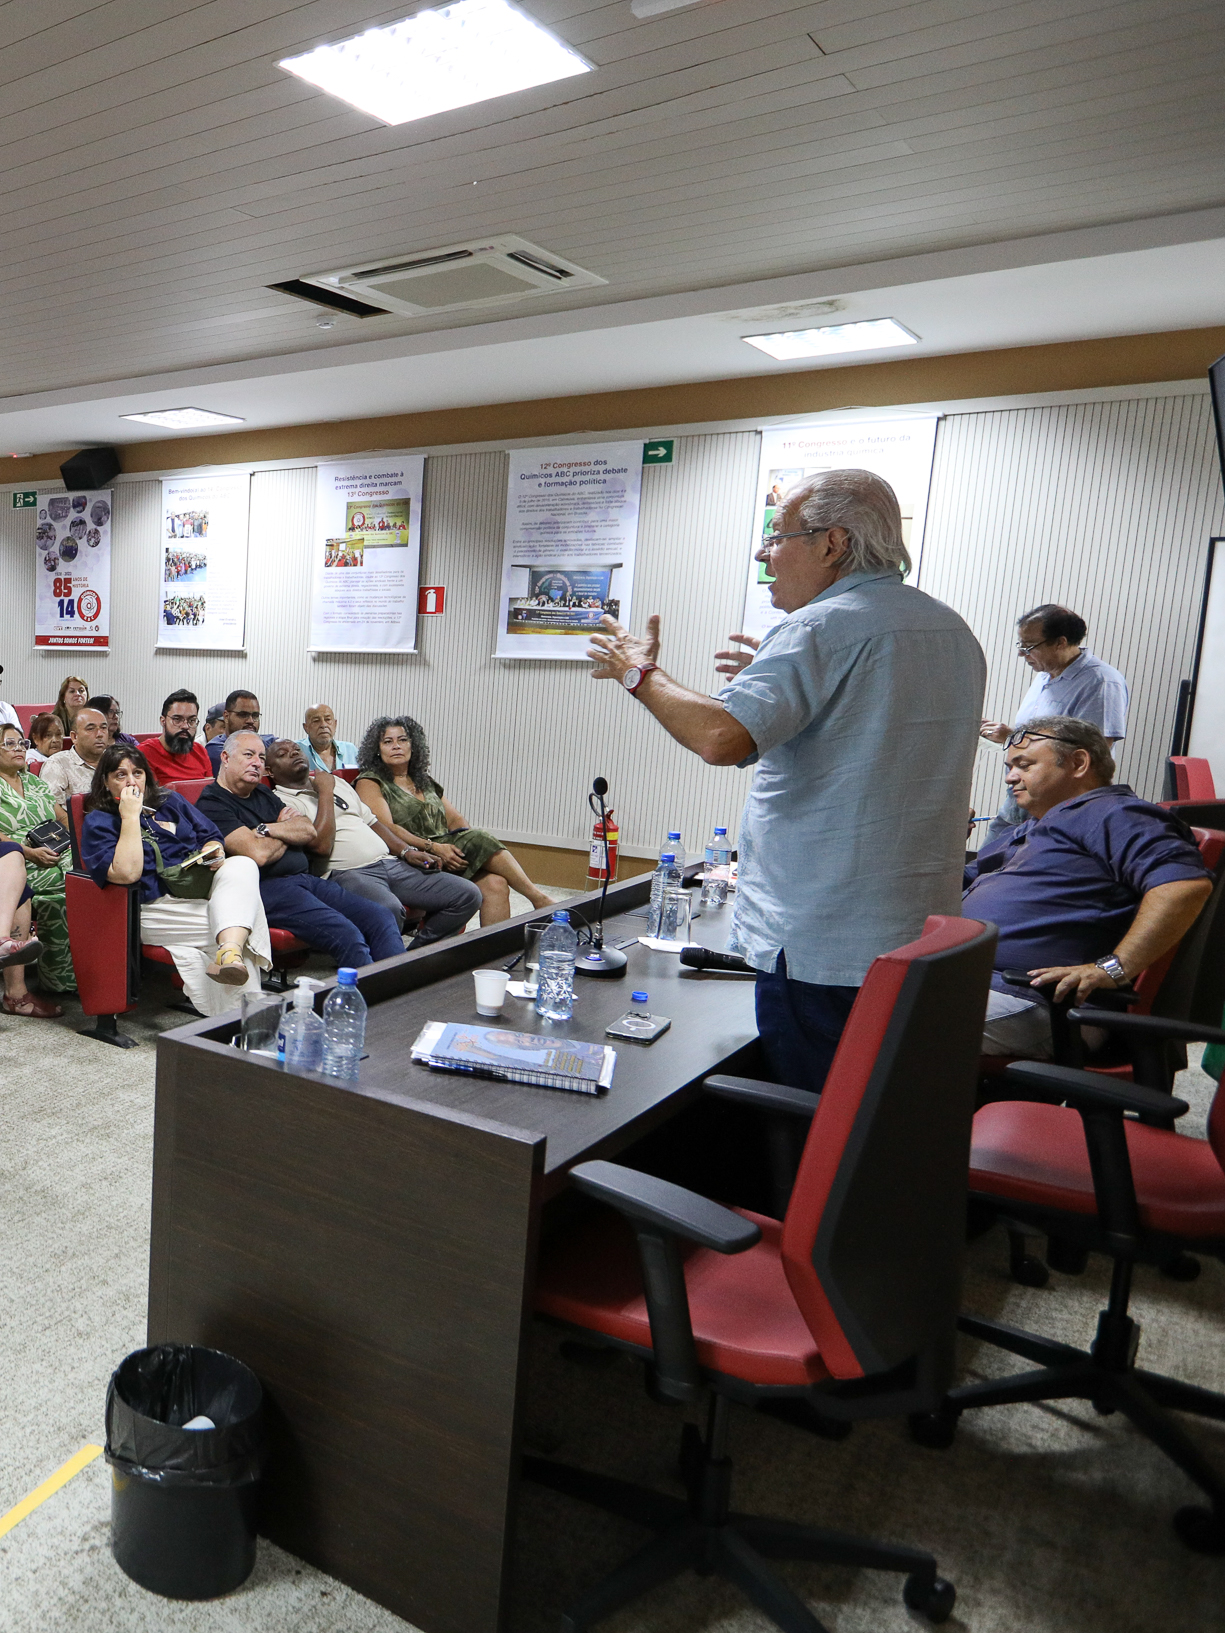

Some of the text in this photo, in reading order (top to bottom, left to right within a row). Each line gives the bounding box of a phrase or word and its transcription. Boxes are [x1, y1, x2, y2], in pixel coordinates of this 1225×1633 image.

[798, 439, 848, 449] Congresso
[867, 436, 897, 444] futuro
[899, 434, 911, 442] da
[540, 462, 551, 470] 12º
[552, 460, 592, 470] Congresso
[334, 474, 367, 482] Resistência
[373, 472, 399, 480] combate
[554, 470, 571, 478] ABC
[572, 468, 600, 478] prioriza
[602, 467, 628, 475] debate
[359, 481, 378, 489] direita
[544, 479, 578, 488] formação
[579, 478, 607, 487] política
[357, 490, 390, 498] Congresso
[53, 577, 73, 598] 85
[57, 598, 75, 619] 14
